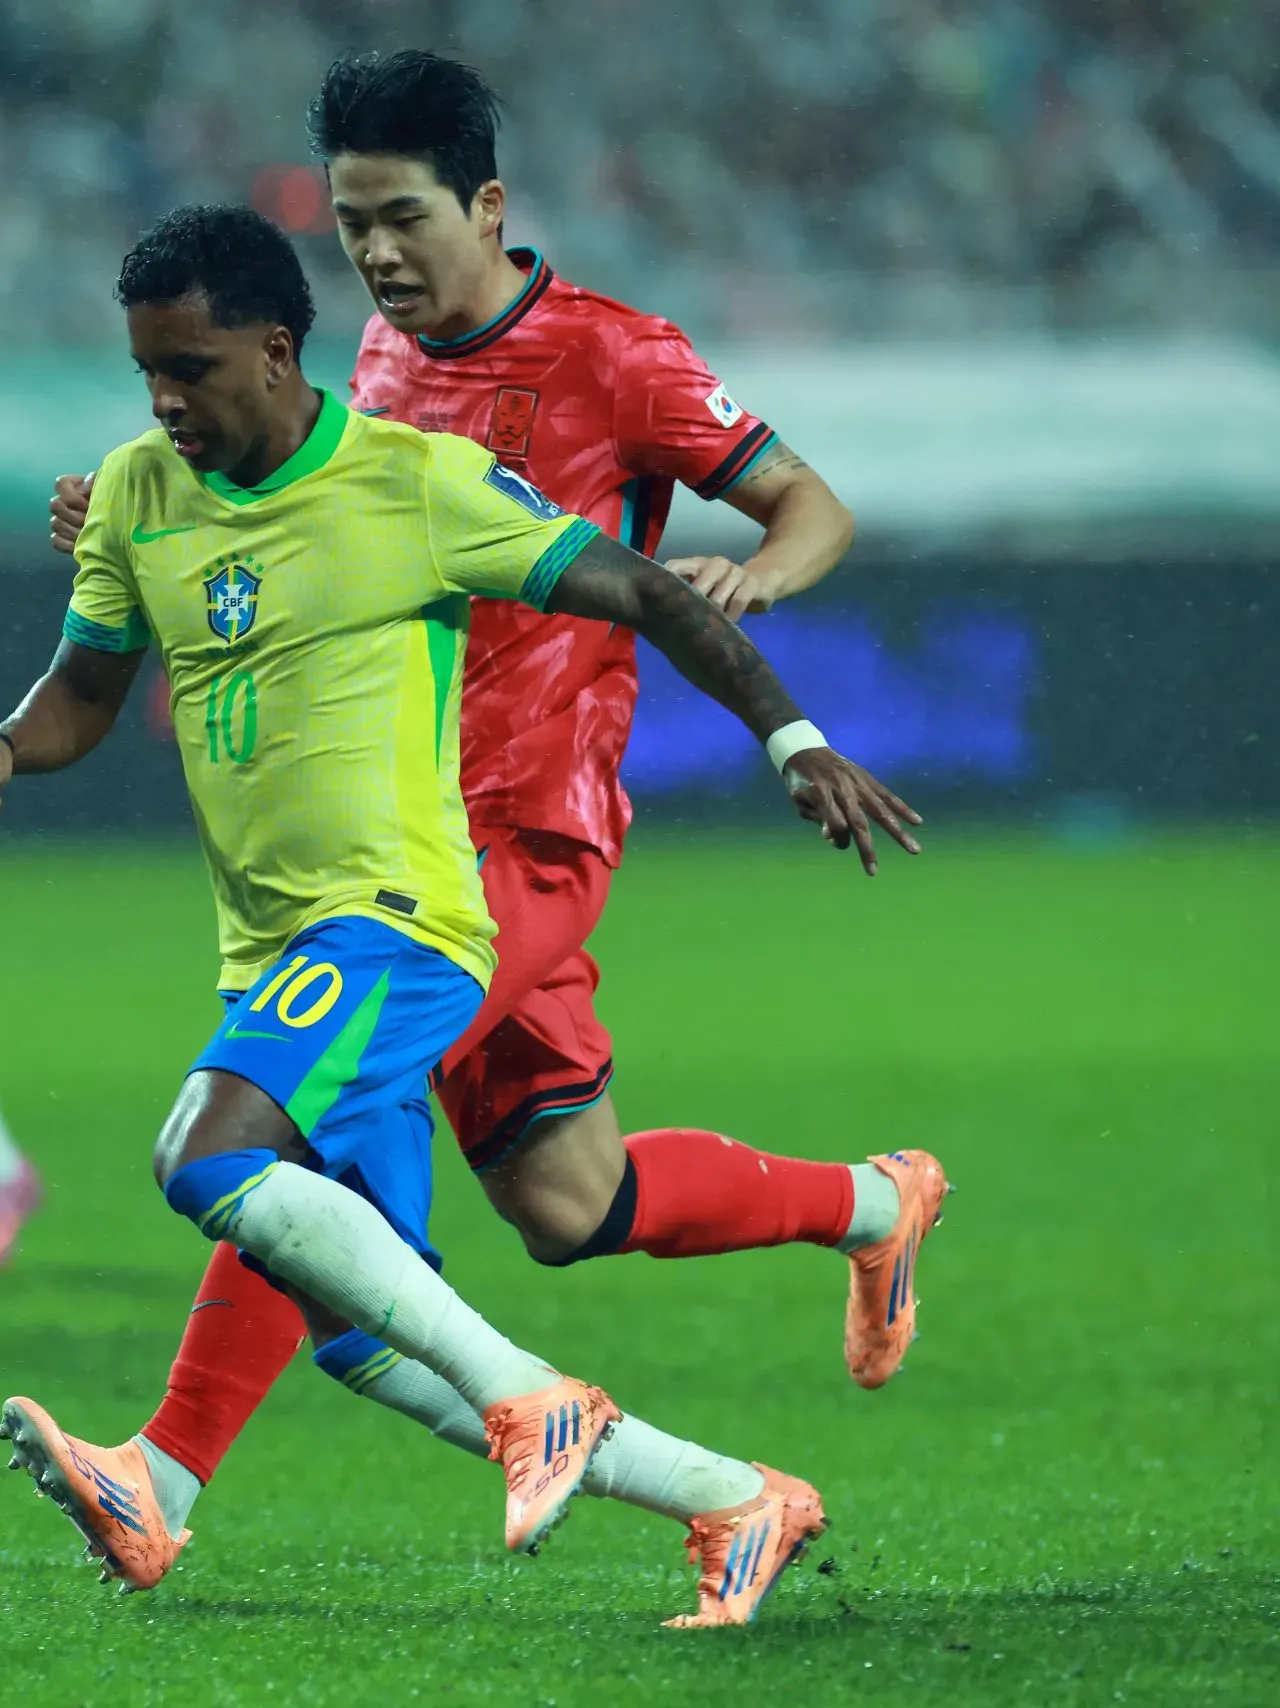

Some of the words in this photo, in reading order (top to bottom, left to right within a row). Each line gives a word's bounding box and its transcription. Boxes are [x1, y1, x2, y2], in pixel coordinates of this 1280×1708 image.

[222, 597, 244, 608] CBF
[205, 670, 258, 764] 10
[249, 955, 344, 1029] 10
